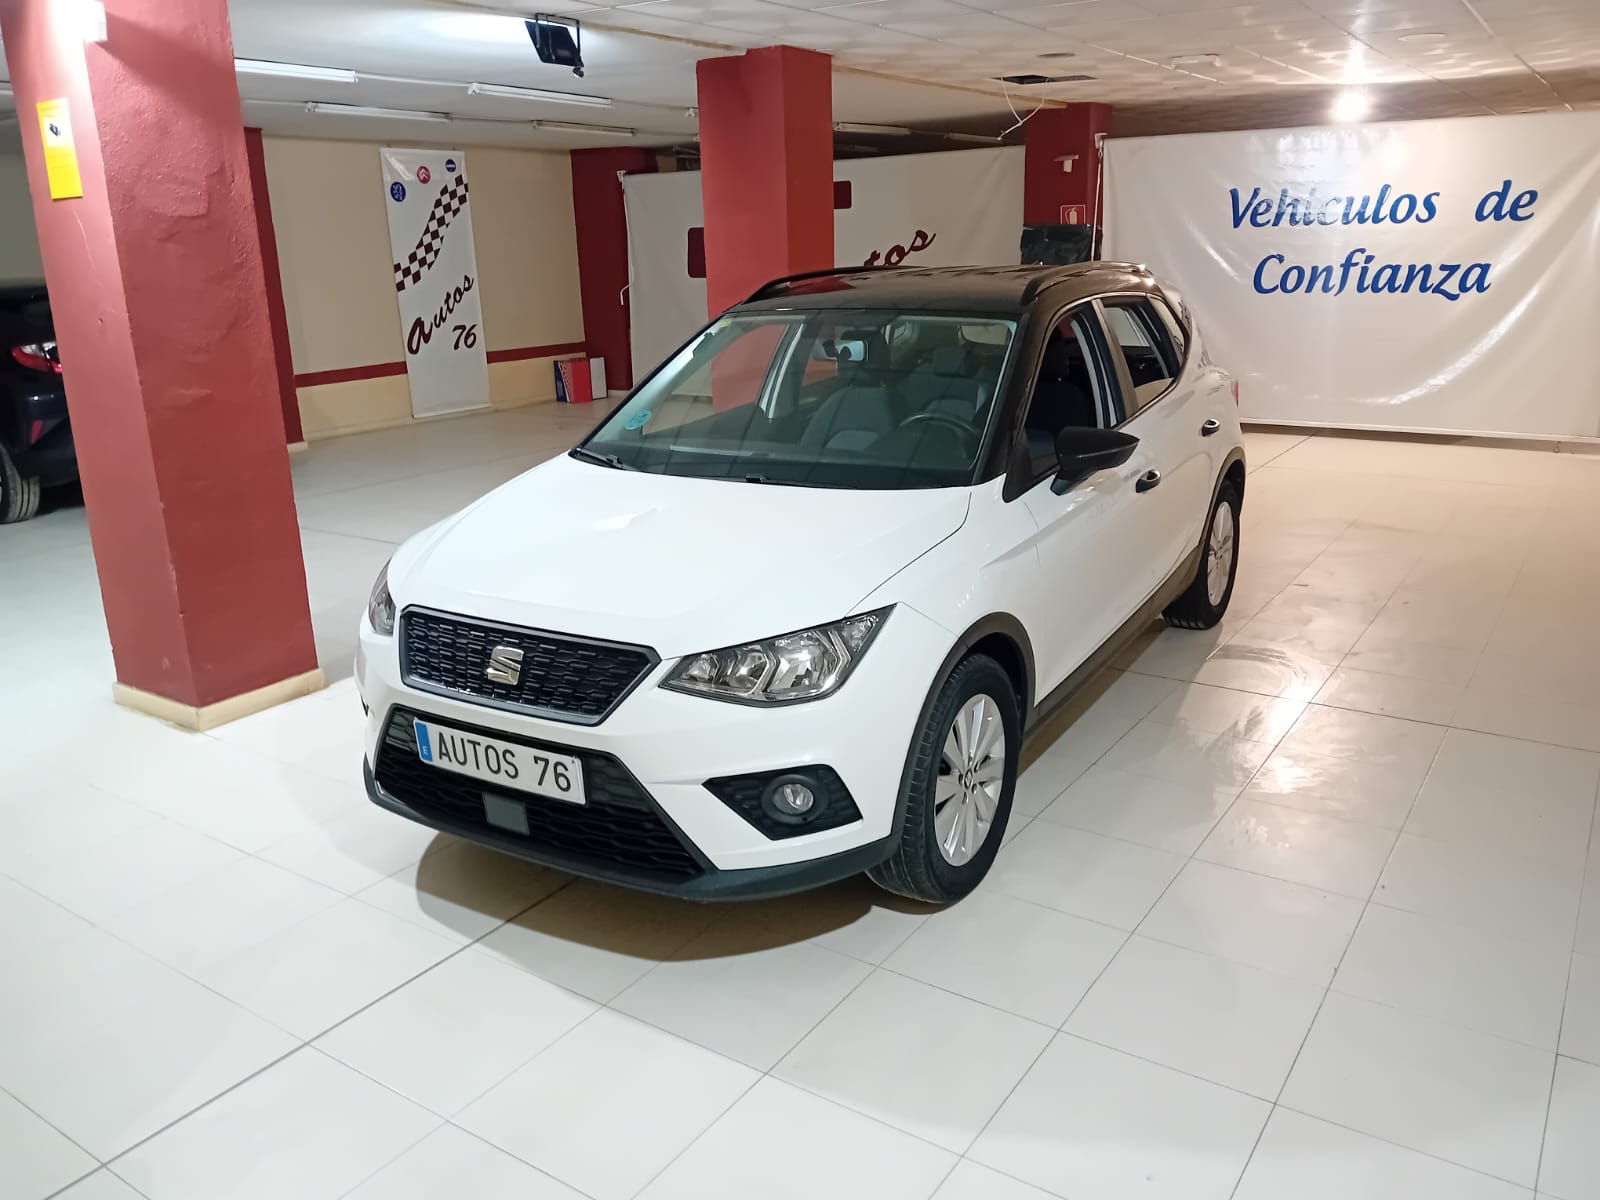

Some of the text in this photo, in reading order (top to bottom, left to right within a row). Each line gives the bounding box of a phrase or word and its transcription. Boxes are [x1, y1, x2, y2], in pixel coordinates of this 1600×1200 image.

[1475, 180, 1538, 222] de
[1253, 248, 1492, 301] Confianza
[452, 324, 478, 351] 76
[438, 731, 572, 792] AUTOS 76
